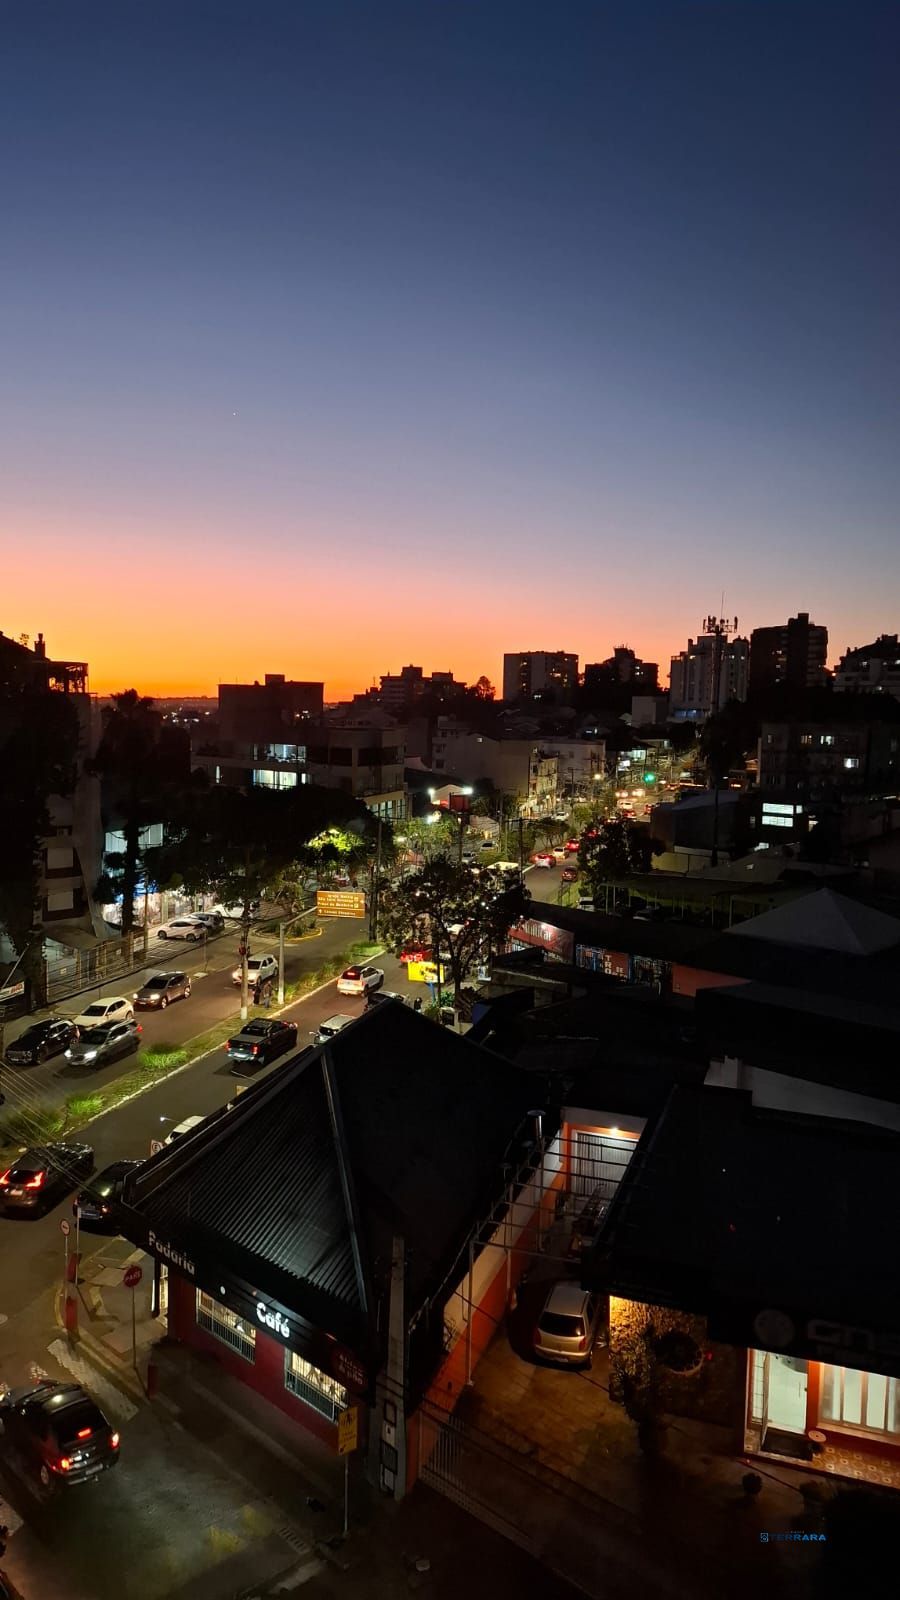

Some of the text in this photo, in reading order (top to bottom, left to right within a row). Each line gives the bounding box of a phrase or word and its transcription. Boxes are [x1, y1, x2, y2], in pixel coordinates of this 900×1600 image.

[148, 1230, 195, 1275] Padaria
[125, 1270, 141, 1281] PARE
[256, 1302, 290, 1338] Café
